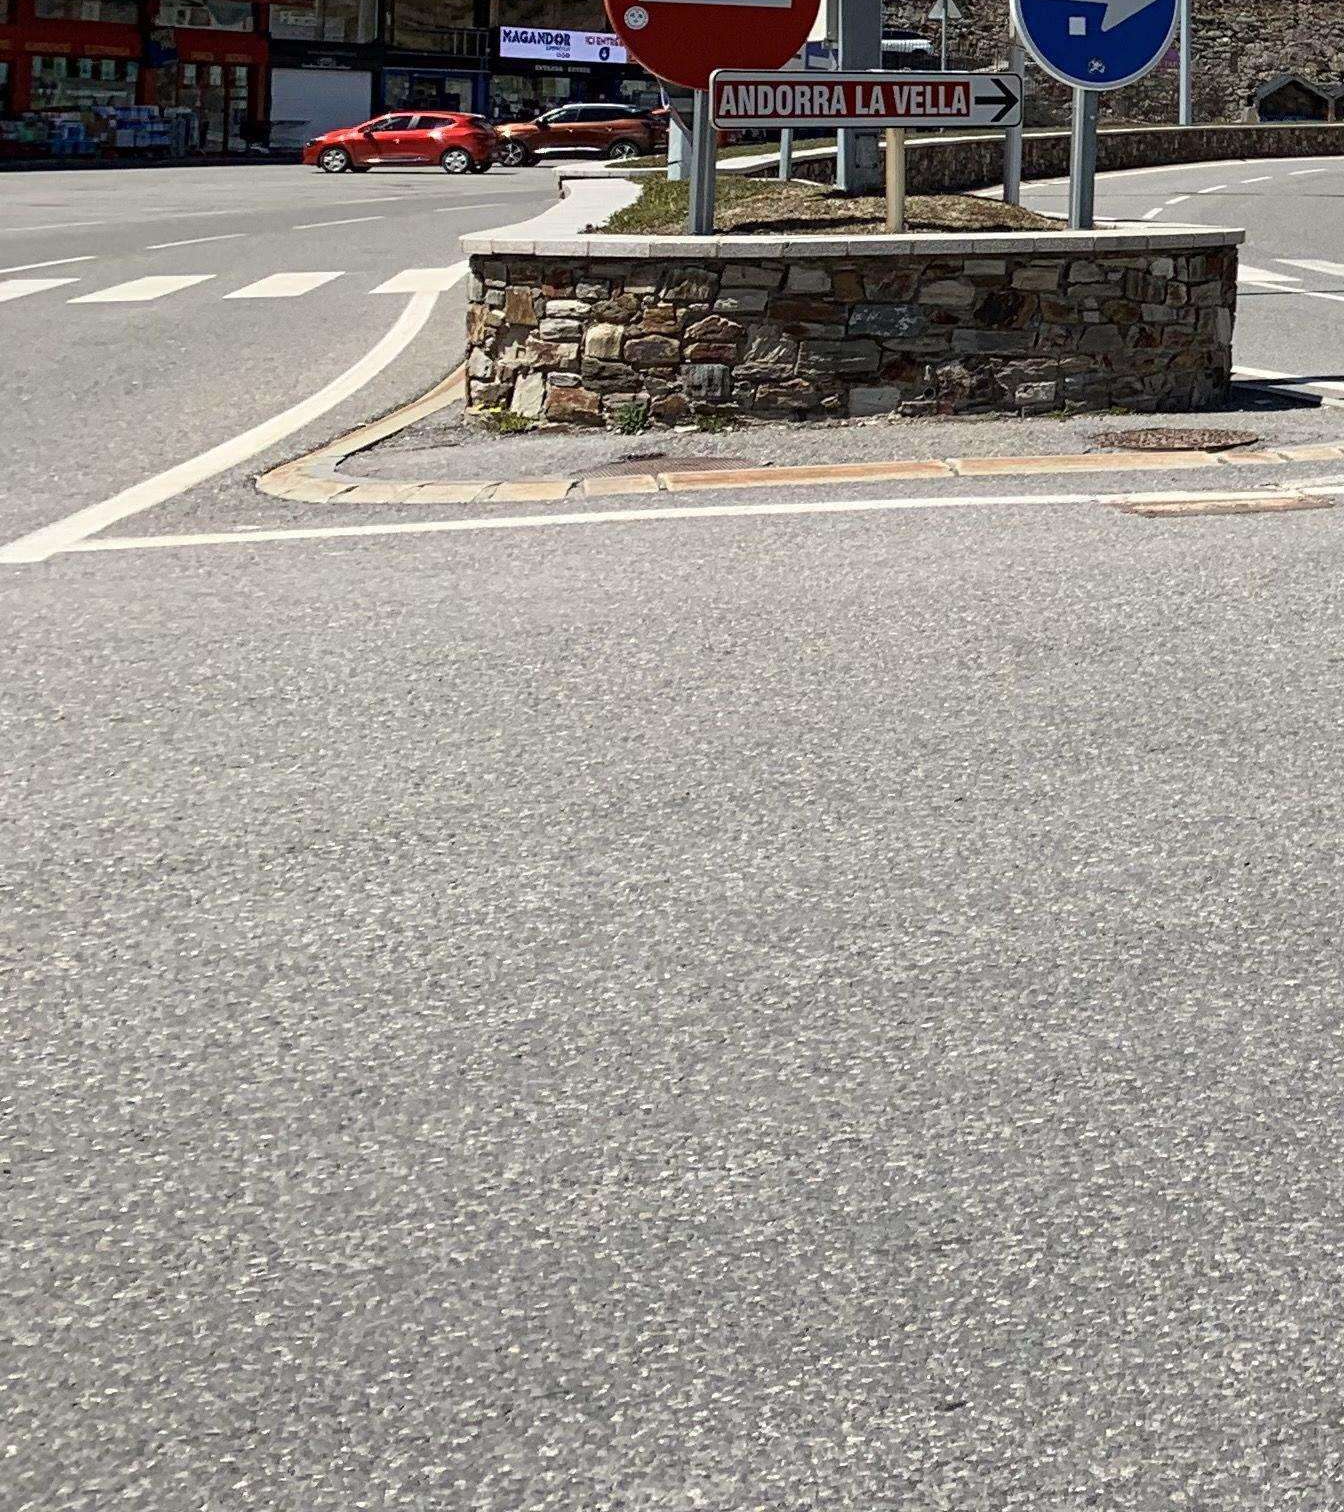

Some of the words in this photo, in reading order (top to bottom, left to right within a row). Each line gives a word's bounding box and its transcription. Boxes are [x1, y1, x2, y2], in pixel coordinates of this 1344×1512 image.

[718, 84, 848, 116] ANDORRA
[855, 85, 887, 115] LA
[892, 85, 969, 115] VELLA
